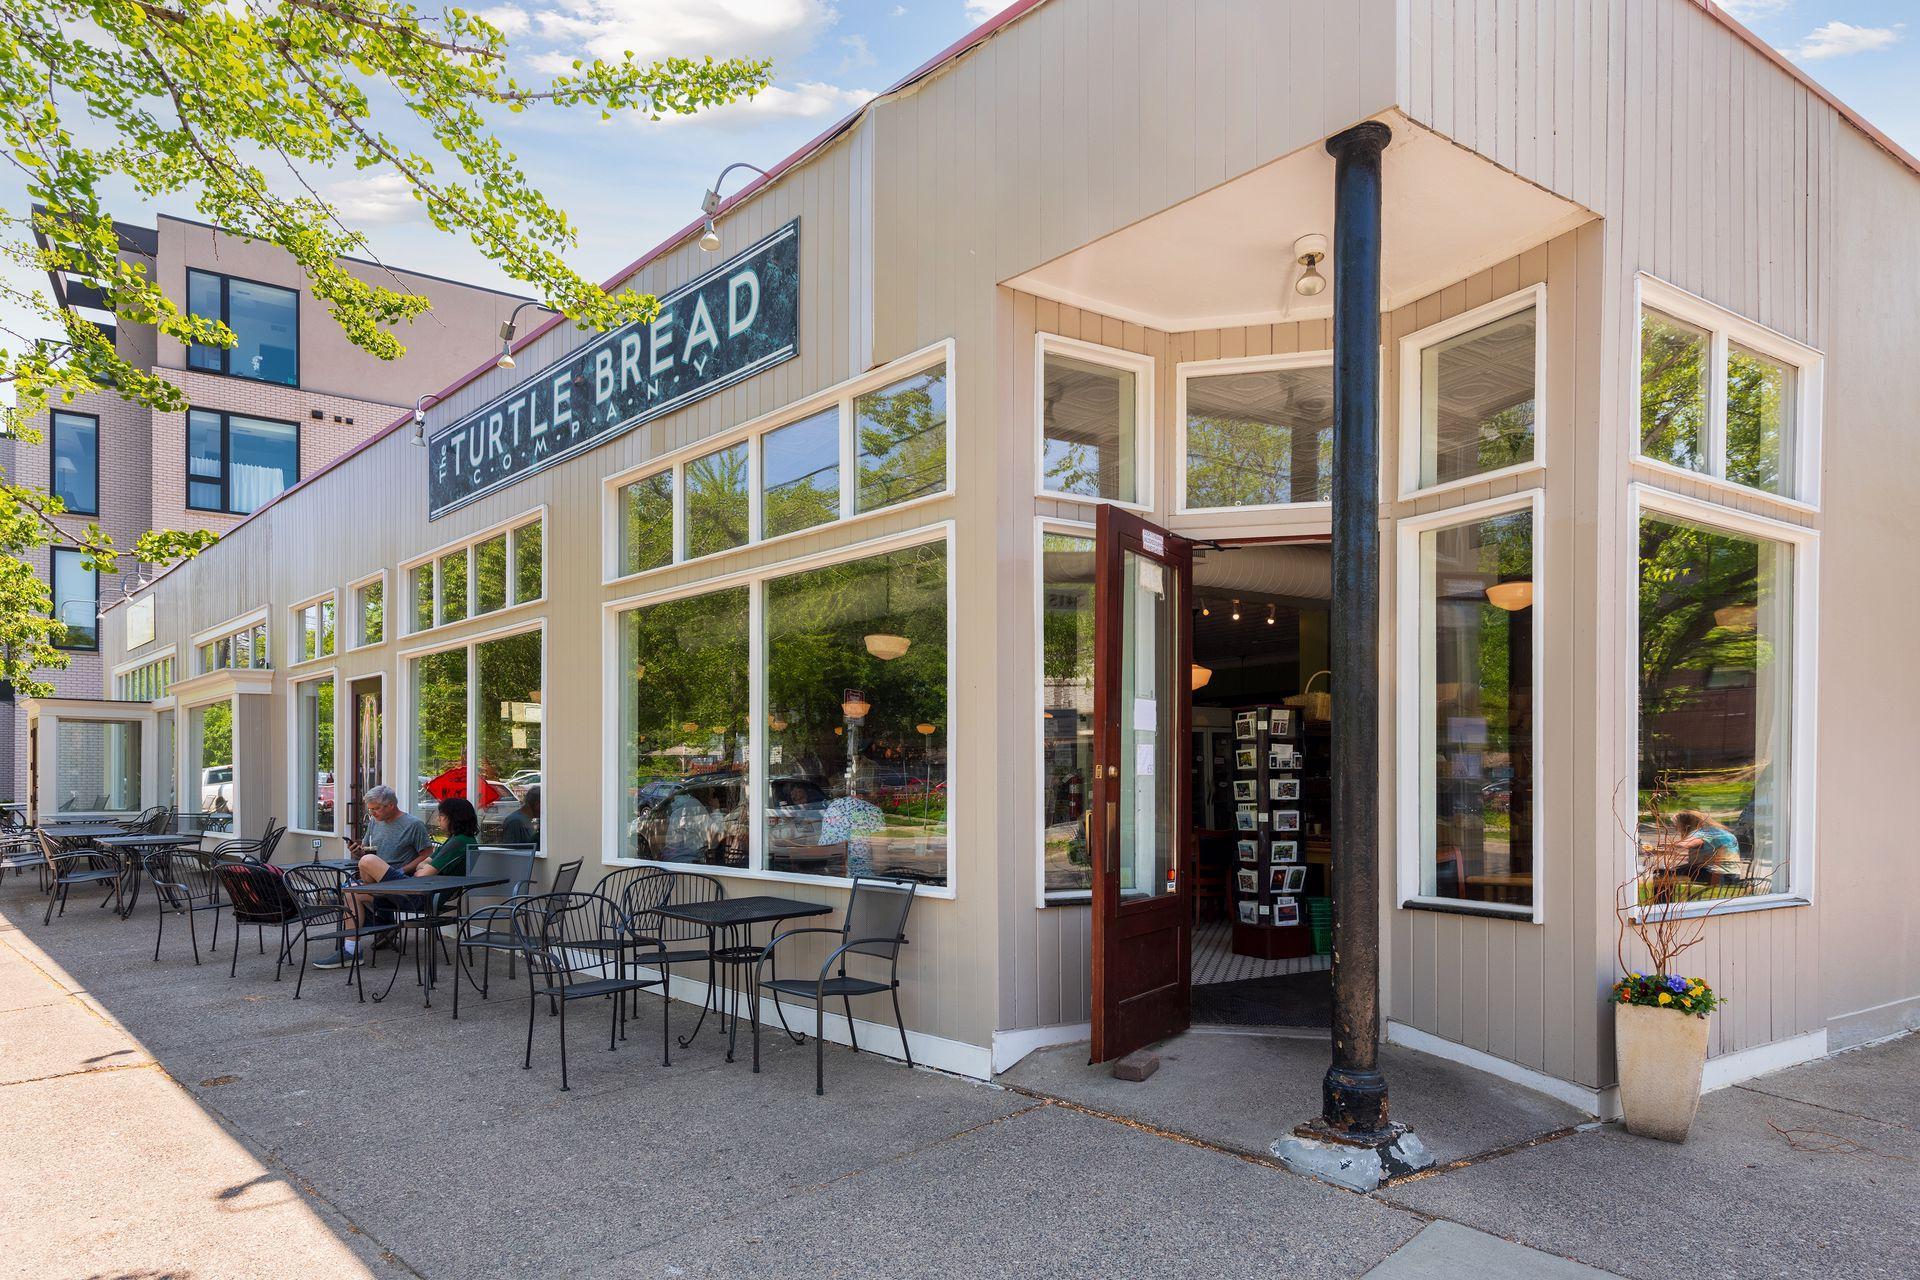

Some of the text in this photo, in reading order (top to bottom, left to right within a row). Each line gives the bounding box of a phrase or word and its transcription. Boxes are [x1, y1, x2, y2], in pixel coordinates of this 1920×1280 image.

[439, 269, 761, 484] The TURTLE BREAD
